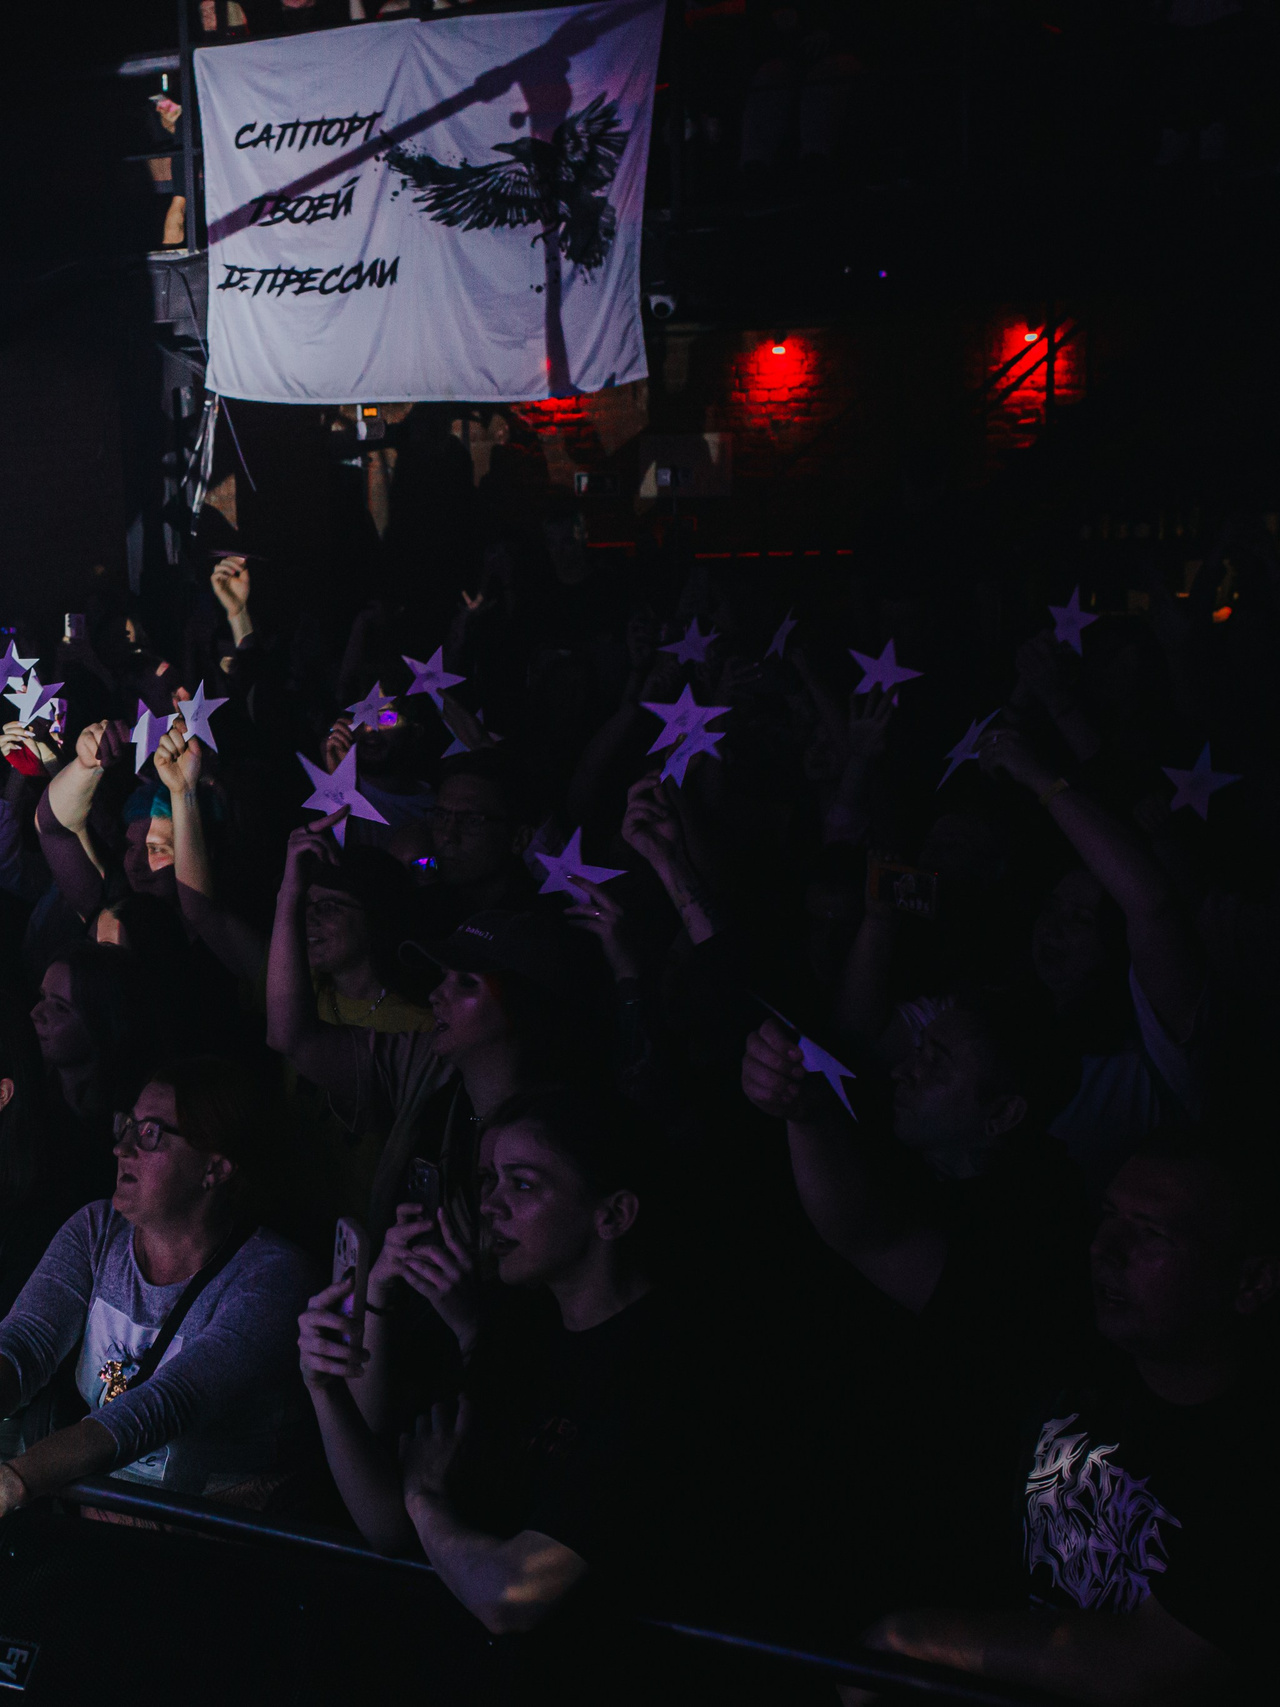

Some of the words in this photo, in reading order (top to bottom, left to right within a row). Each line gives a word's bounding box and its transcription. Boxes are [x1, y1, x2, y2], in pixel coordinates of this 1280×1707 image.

[235, 111, 385, 153] САППОРТ
[248, 175, 362, 227] ТВОЕЙ
[216, 256, 400, 298] ДЕПРЕССИИ
